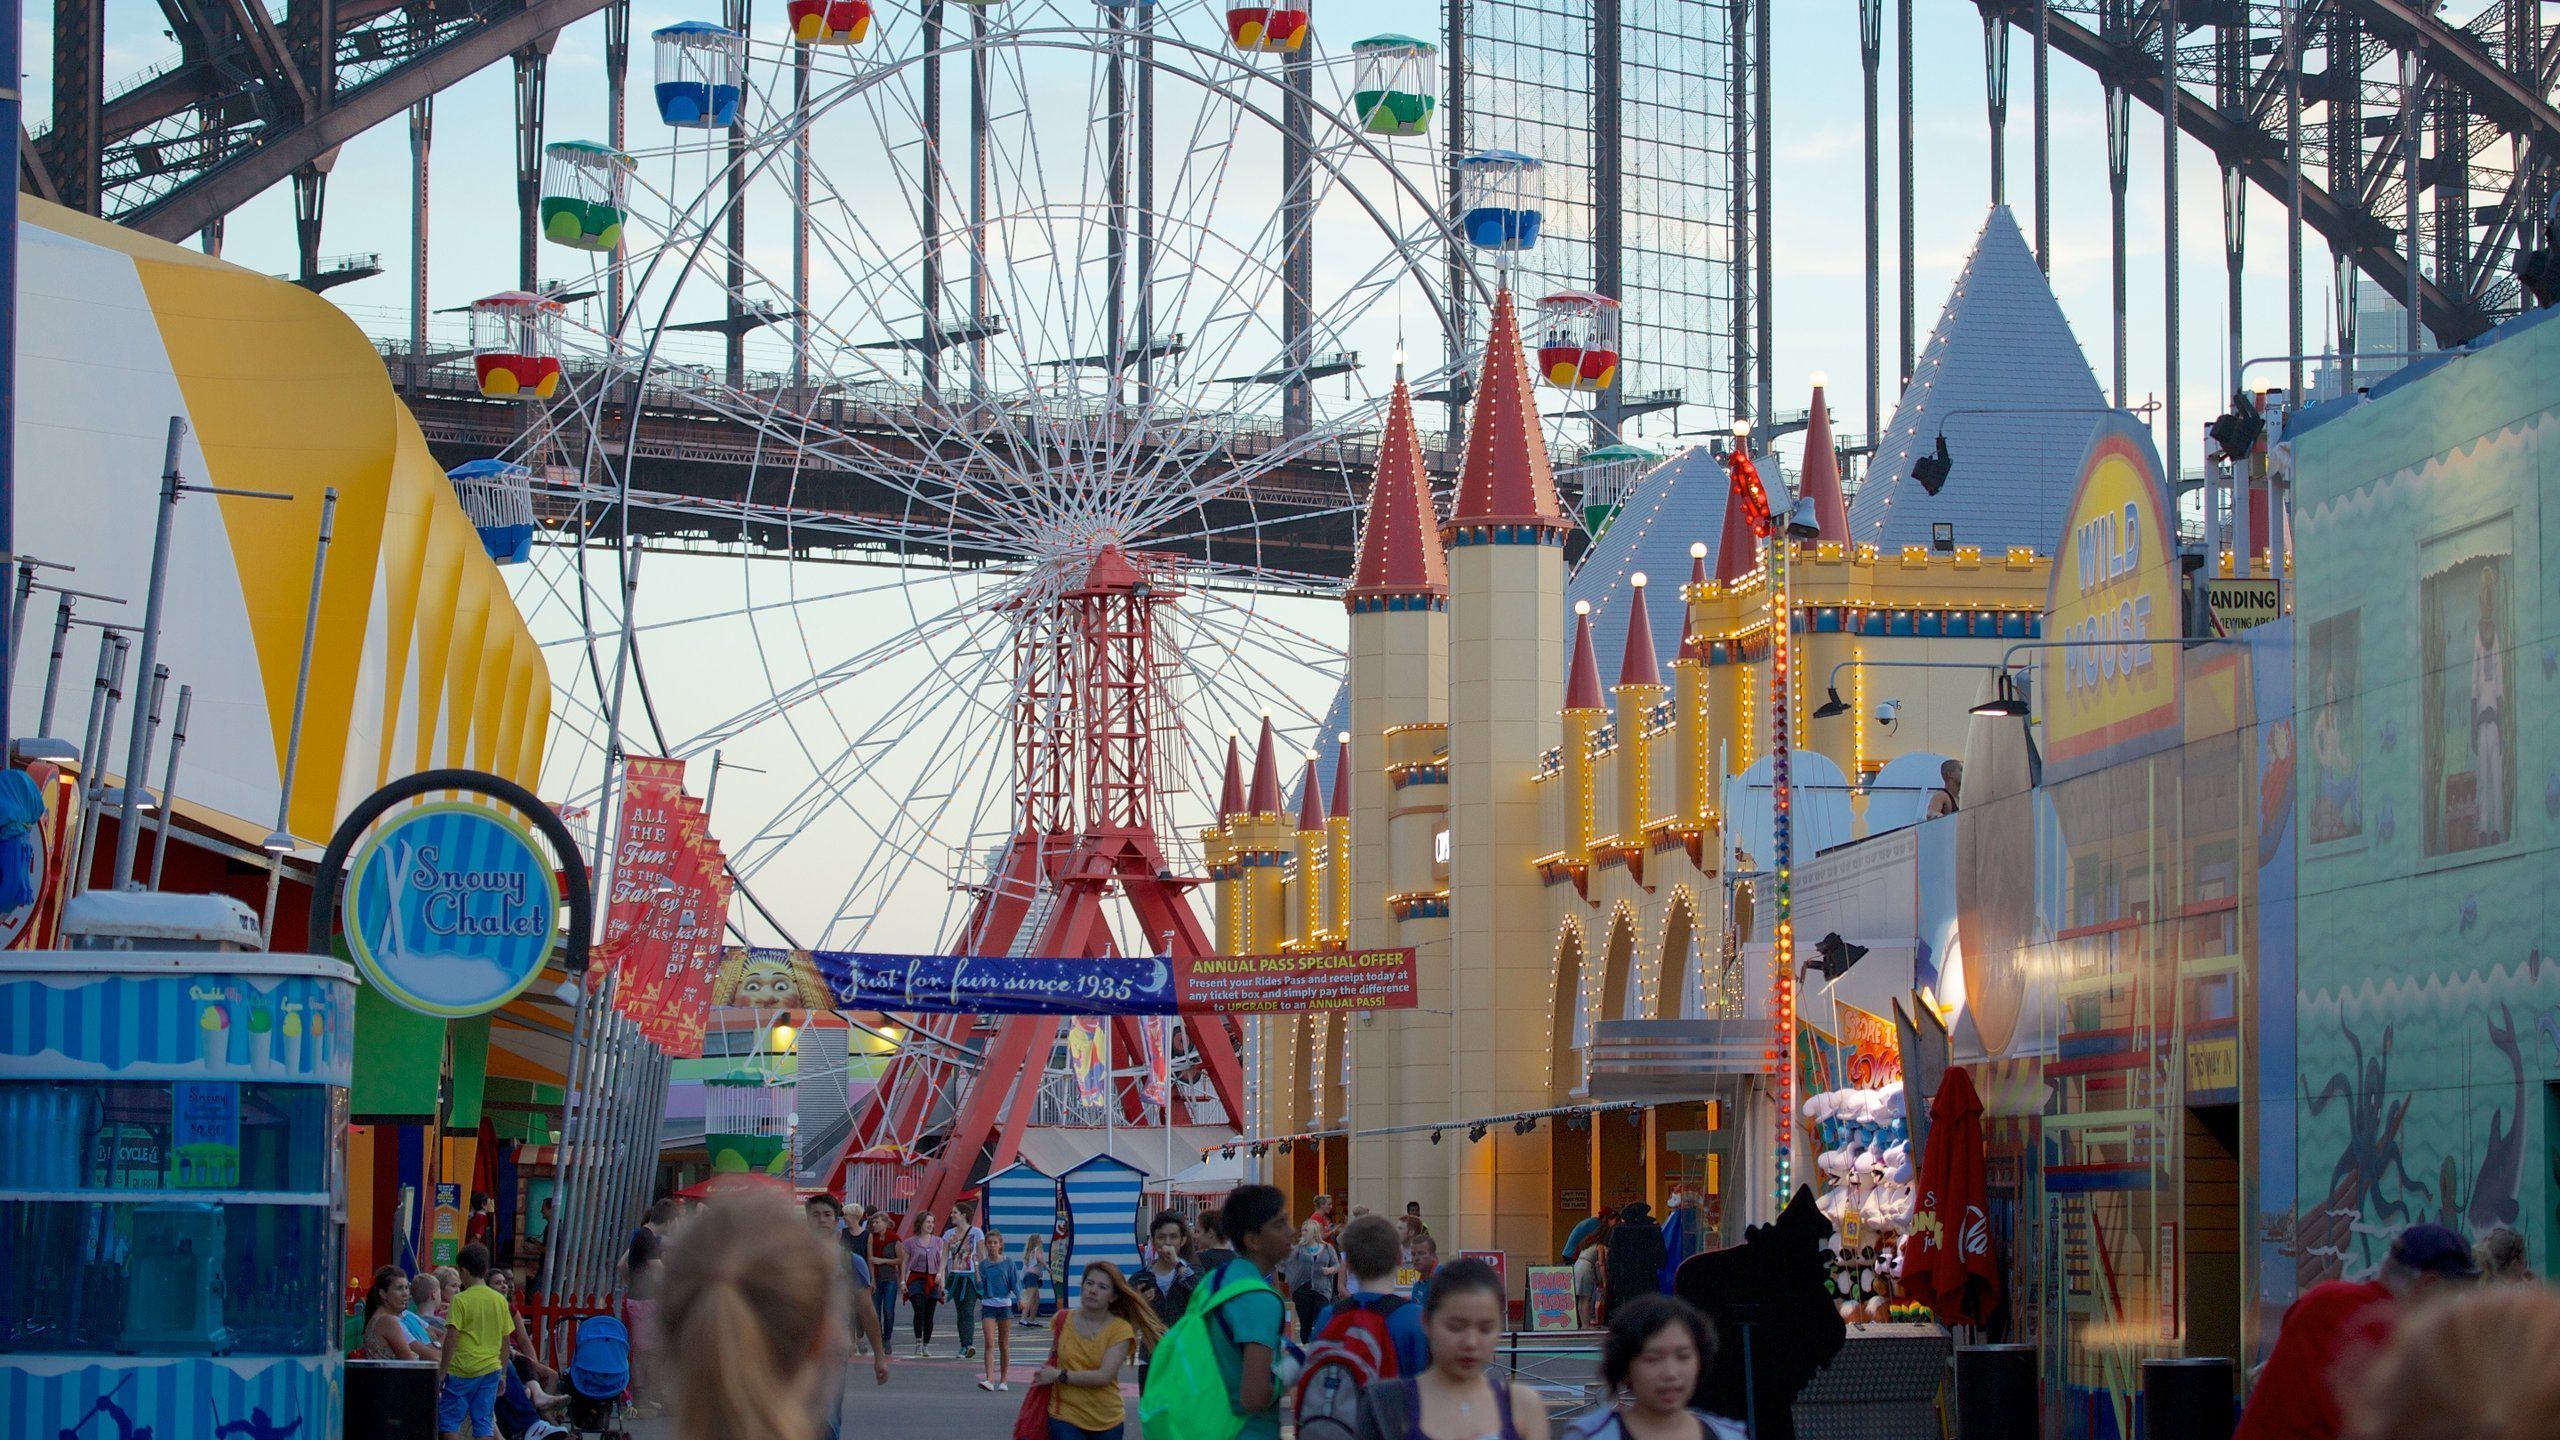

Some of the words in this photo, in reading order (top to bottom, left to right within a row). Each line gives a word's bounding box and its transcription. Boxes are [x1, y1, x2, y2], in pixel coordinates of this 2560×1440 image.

[2077, 500, 2140, 591] WILD
[2209, 591, 2276, 608] ANDING
[2064, 593, 2152, 693] MOUSE
[632, 808, 668, 823] ALL
[630, 825, 666, 842] THE
[618, 841, 667, 866] Fun
[412, 845, 526, 907] Snowy
[618, 868, 635, 879] OF
[638, 870, 663, 882] THE
[423, 890, 544, 936] Chalet
[1193, 960, 1256, 973] ANNUAL
[1260, 958, 1294, 971] PASS
[1298, 955, 1356, 970] SPECIAL
[1359, 953, 1404, 967] OFFER
[841, 963, 897, 1003] Just
[905, 959, 945, 1004] for
[950, 958, 1000, 1005] fun
[1004, 974, 1072, 992] since
[1077, 974, 1134, 1000] 1935
[1189, 978, 1227, 988] Present
[1230, 979, 1252, 989] your
[1255, 976, 1282, 986] Rides
[1284, 976, 1306, 985] Pass
[1308, 974, 1327, 984] and
[1329, 972, 1364, 984] receipt
[1366, 971, 1396, 982] today
[1397, 970, 1408, 979] at
[1189, 993, 1208, 1002] any
[1210, 990, 1239, 1000] ticket
[1241, 989, 1260, 999] box
[1262, 989, 1281, 998] and
[1283, 987, 1317, 999] simply
[1319, 988, 1338, 999] pay
[1340, 985, 1357, 995] the
[1359, 984, 1410, 994] difference
[1214, 1003, 1225, 1011] to
[1227, 1001, 1278, 1011] UPGRADE
[1280, 1002, 1291, 1010] to
[1293, 1001, 1307, 1010] an
[1309, 999, 1355, 1009] ANNUAL
[1357, 996, 1386, 1007] PASS!
[1844, 1011, 1882, 1044] SCORE
[2223, 1048, 2232, 1075] IN
[108, 1147, 148, 1161] CYCLE
[1531, 1272, 1573, 1291] FAIRY
